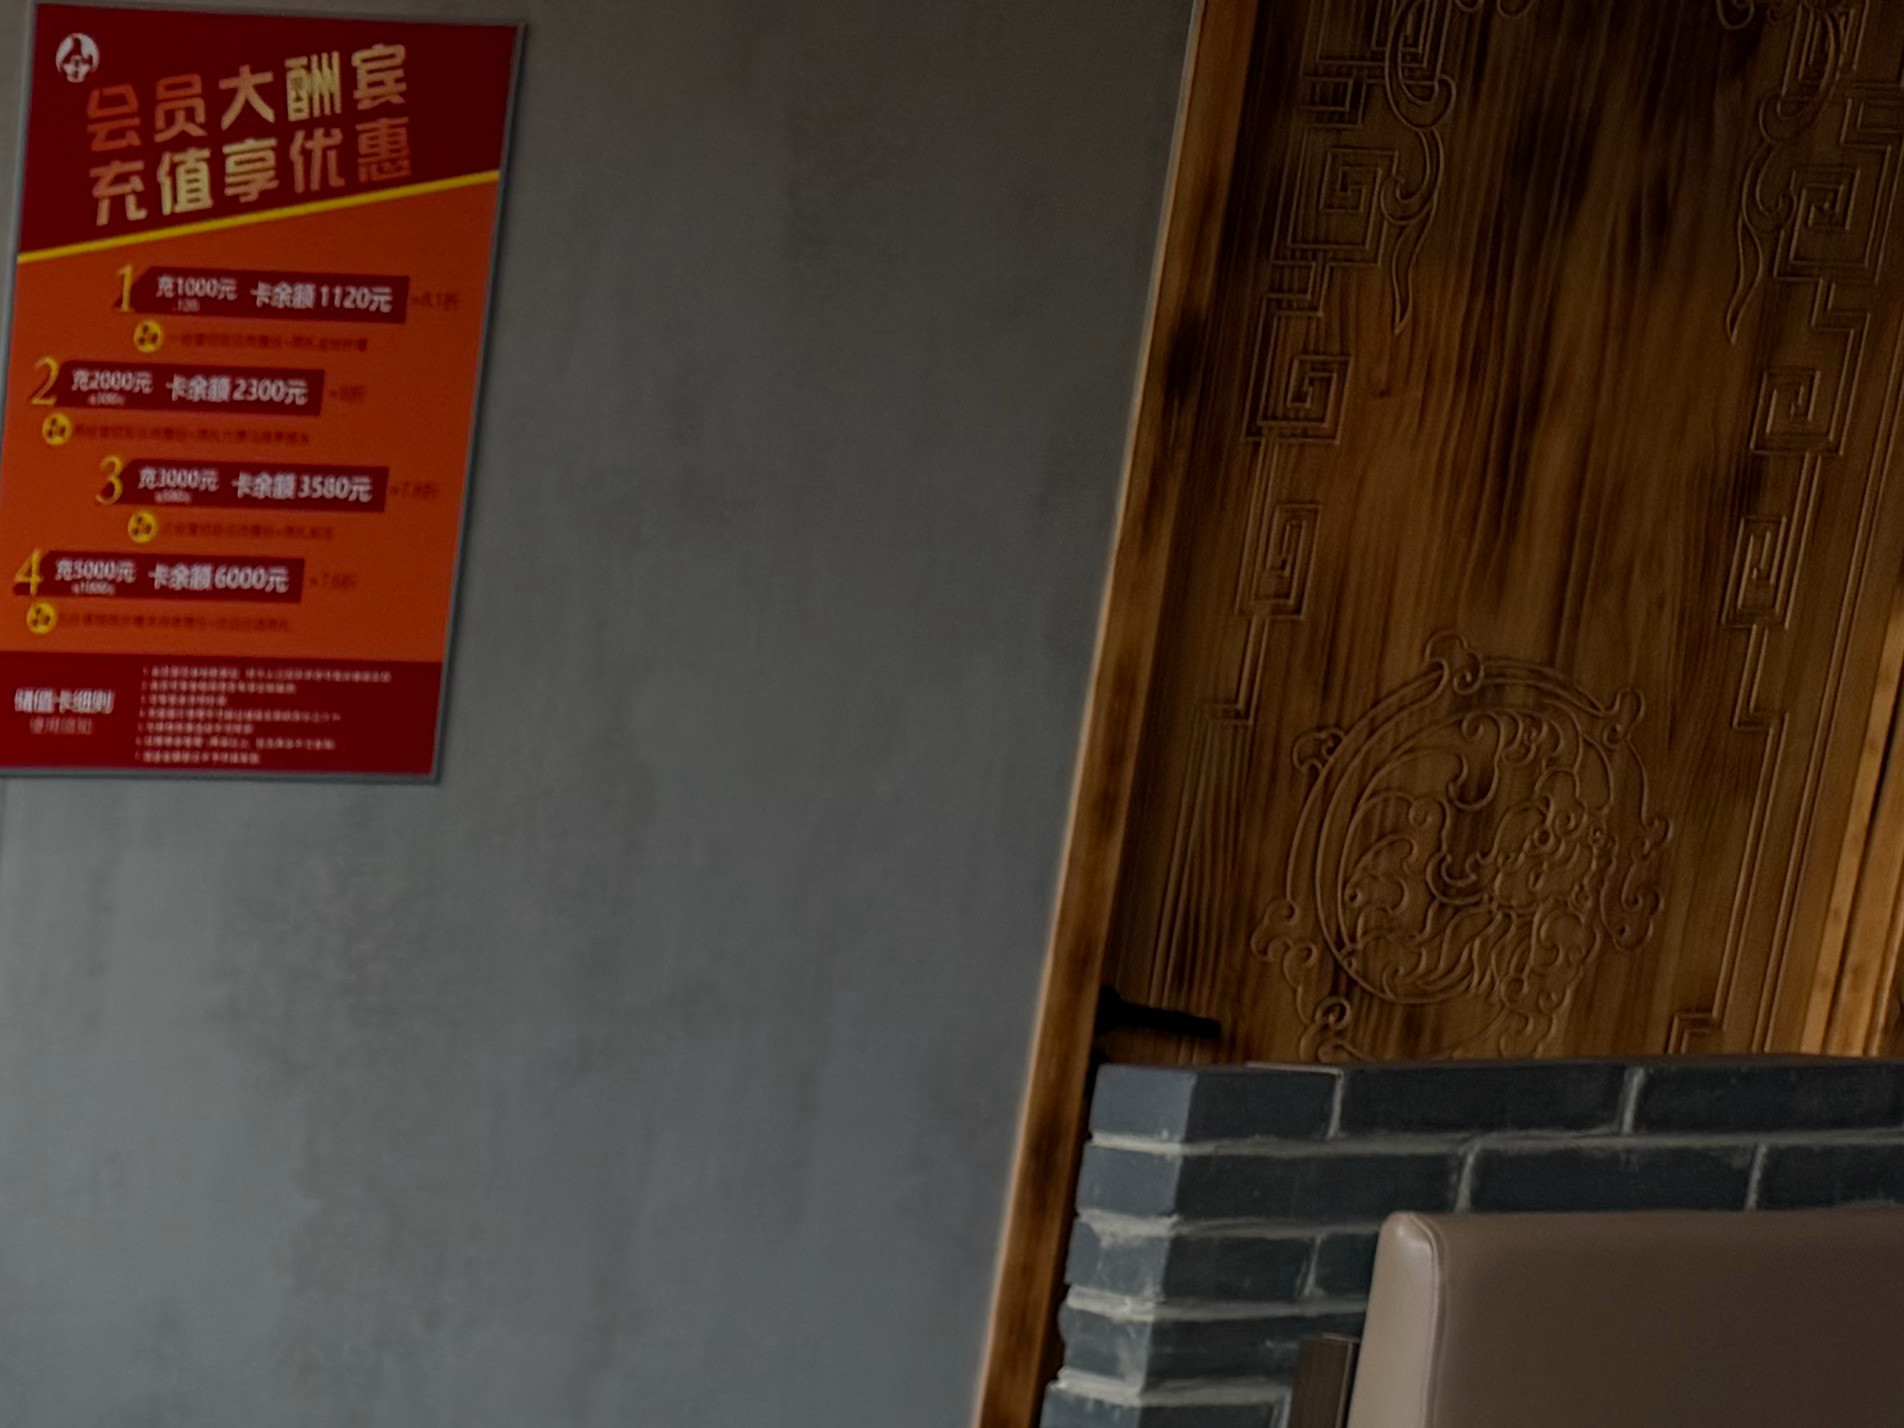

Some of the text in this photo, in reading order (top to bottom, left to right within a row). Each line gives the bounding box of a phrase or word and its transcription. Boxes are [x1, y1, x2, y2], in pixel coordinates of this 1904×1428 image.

[86, 43, 407, 151] 会员大酬宾
[90, 117, 411, 226] 充值享优惠
[117, 264, 135, 313] 1
[156, 275, 237, 300] 充1000元
[251, 280, 392, 313] 卡余额1120元
[31, 356, 59, 406] 2
[71, 368, 153, 394] 充2000元
[166, 373, 308, 406] 卡余额2300元
[96, 455, 123, 505] 3
[138, 466, 219, 491] 充3000元
[232, 471, 372, 503] 卡余额3580元
[14, 547, 42, 596] 4
[55, 558, 136, 583] 充5000元
[148, 563, 289, 593] 卡余额6000元
